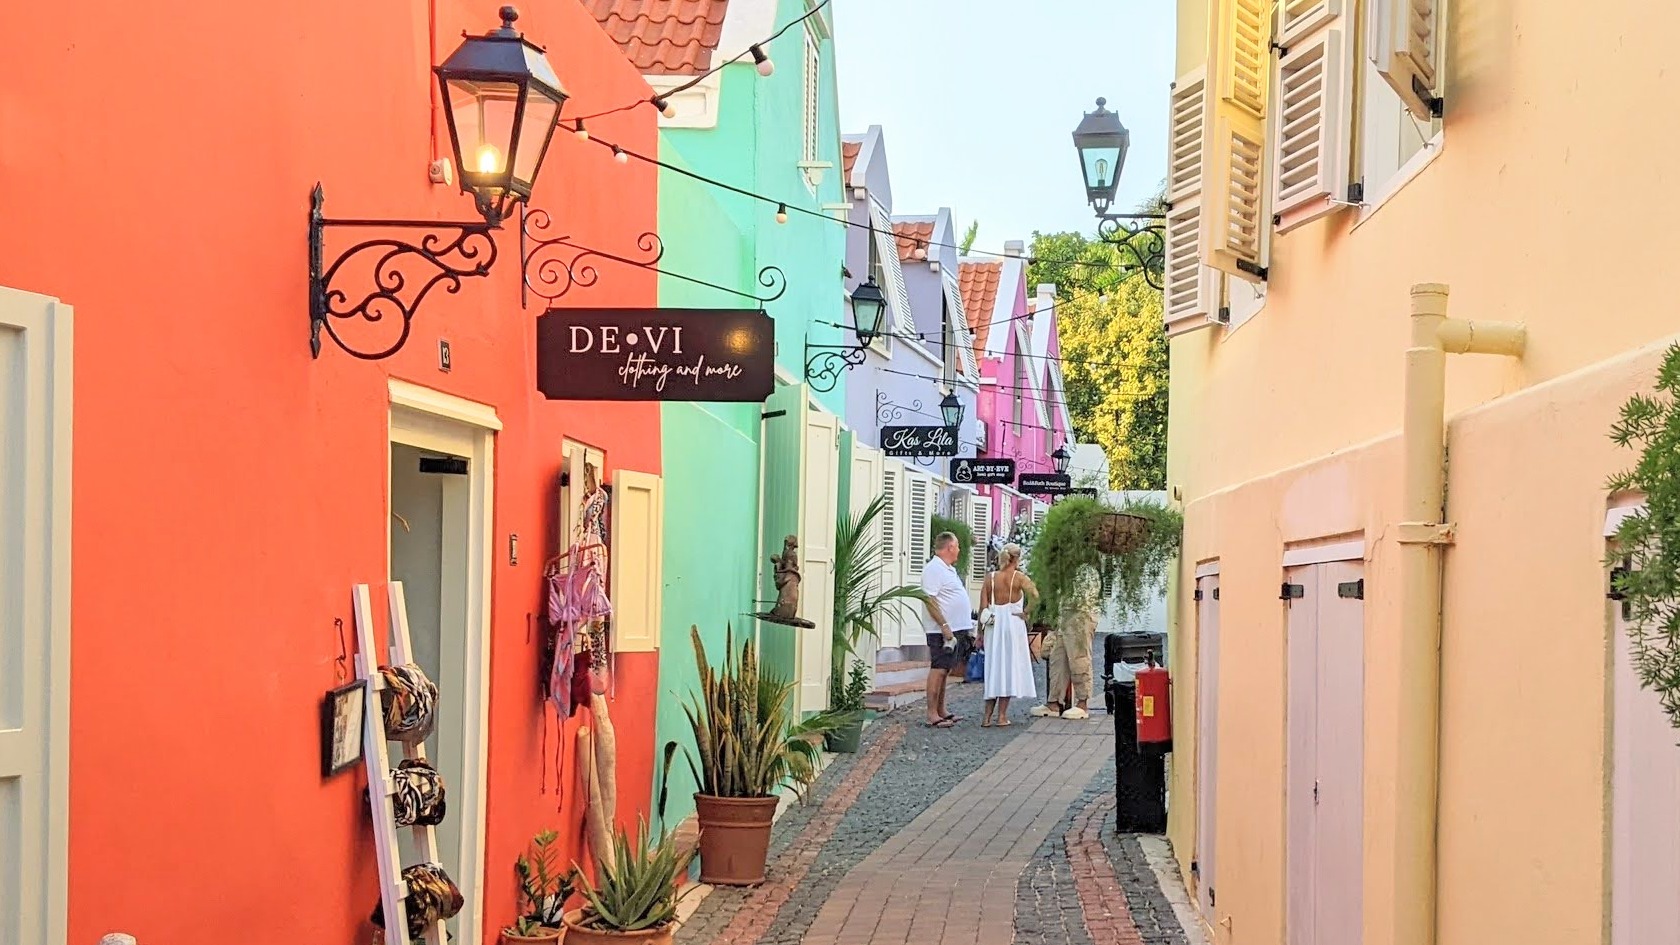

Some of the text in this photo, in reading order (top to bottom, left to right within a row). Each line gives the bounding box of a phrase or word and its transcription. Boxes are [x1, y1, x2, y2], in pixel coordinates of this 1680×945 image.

[618, 352, 743, 392] clothing and more
[884, 427, 954, 452] Kas Lila
